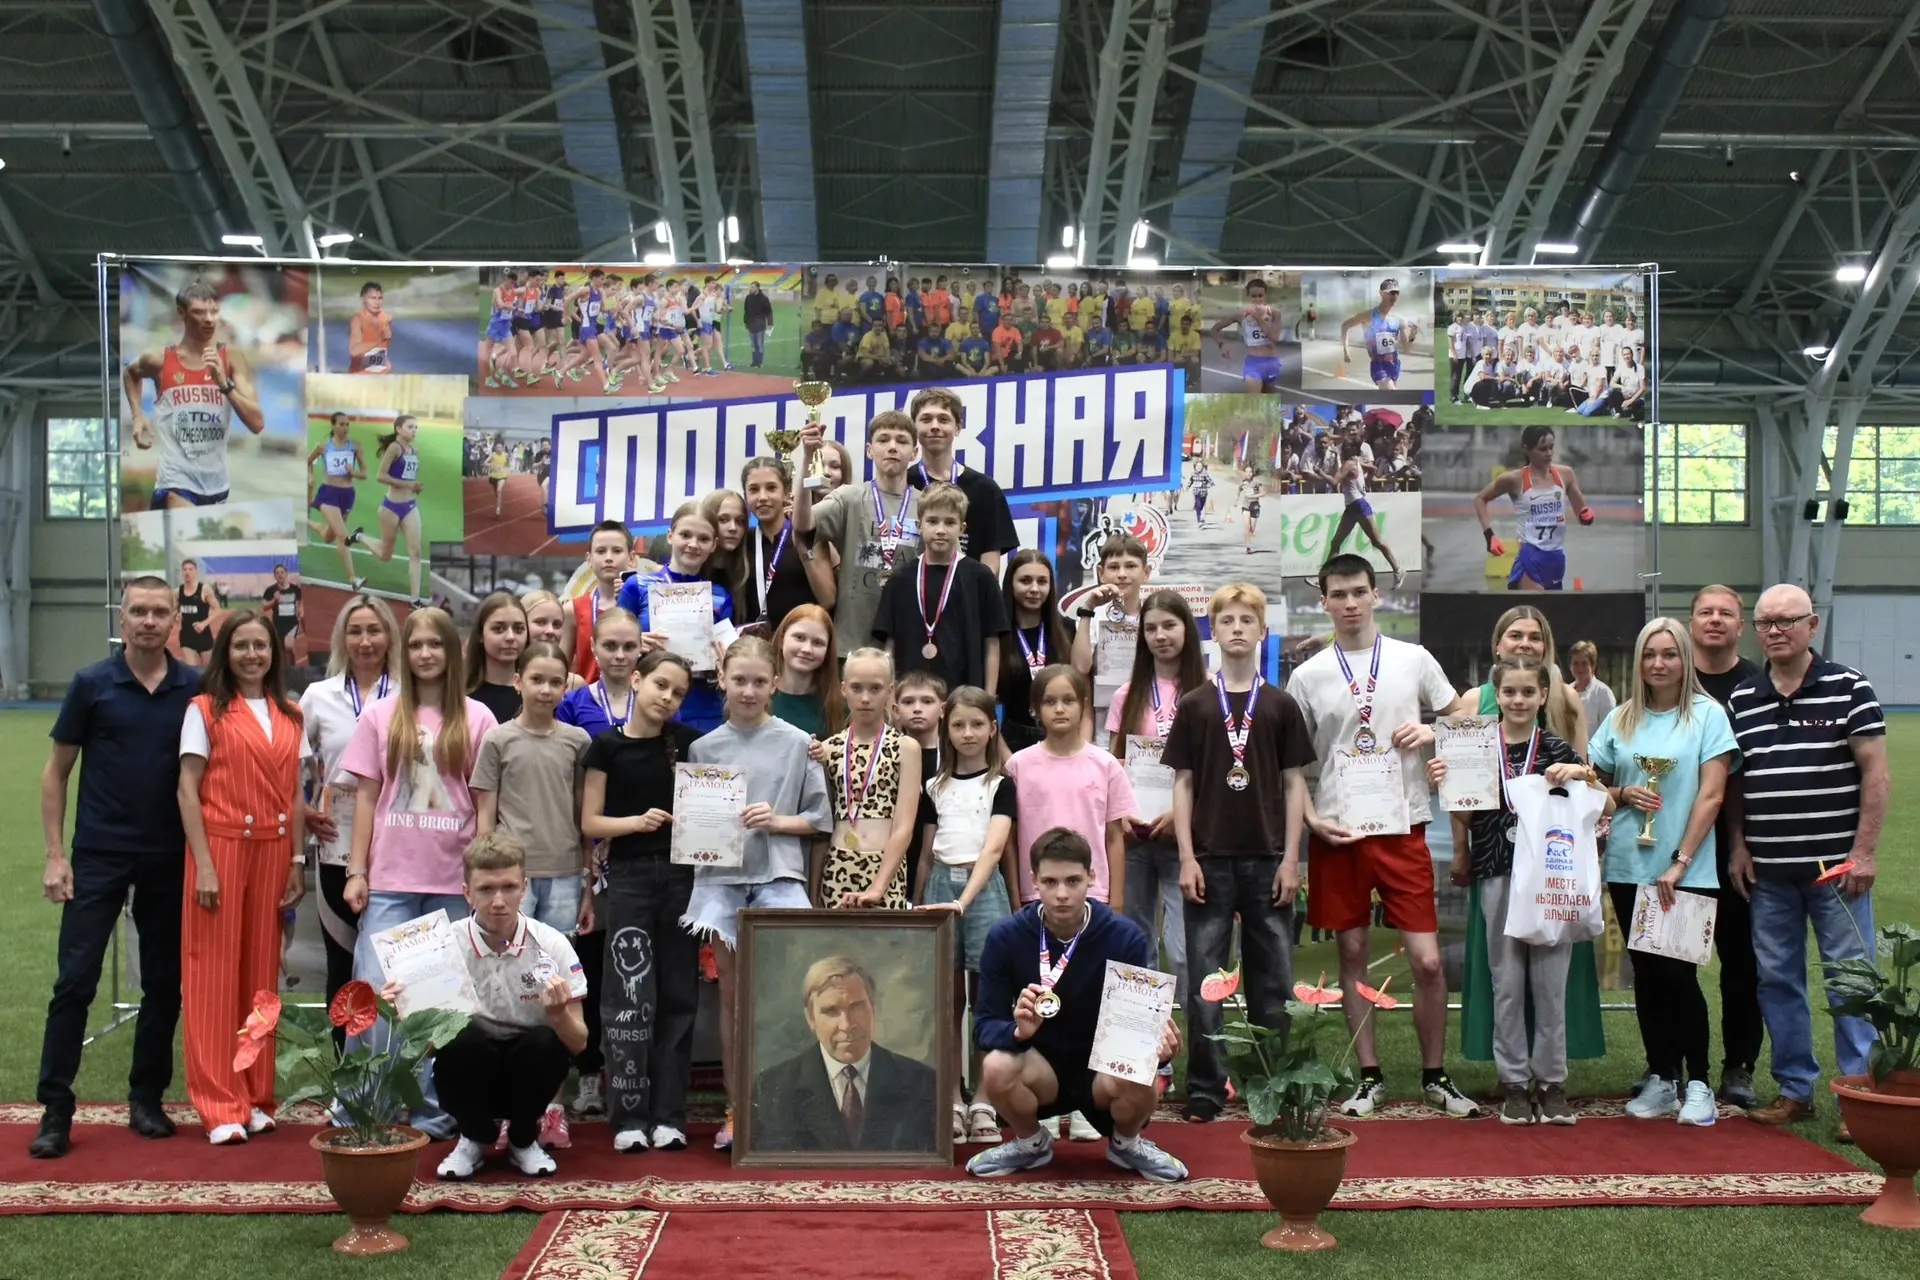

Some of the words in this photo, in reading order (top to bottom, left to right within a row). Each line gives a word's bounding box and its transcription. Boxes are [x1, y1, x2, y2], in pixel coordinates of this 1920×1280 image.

[172, 386, 223, 406] RUSSIA
[188, 411, 221, 423] TDK
[1535, 525, 1557, 540] 77
[1446, 731, 1485, 739] ГРАМОТА
[689, 780, 732, 790] ГРАМОТА
[1117, 981, 1159, 999] ГРАМОТА
